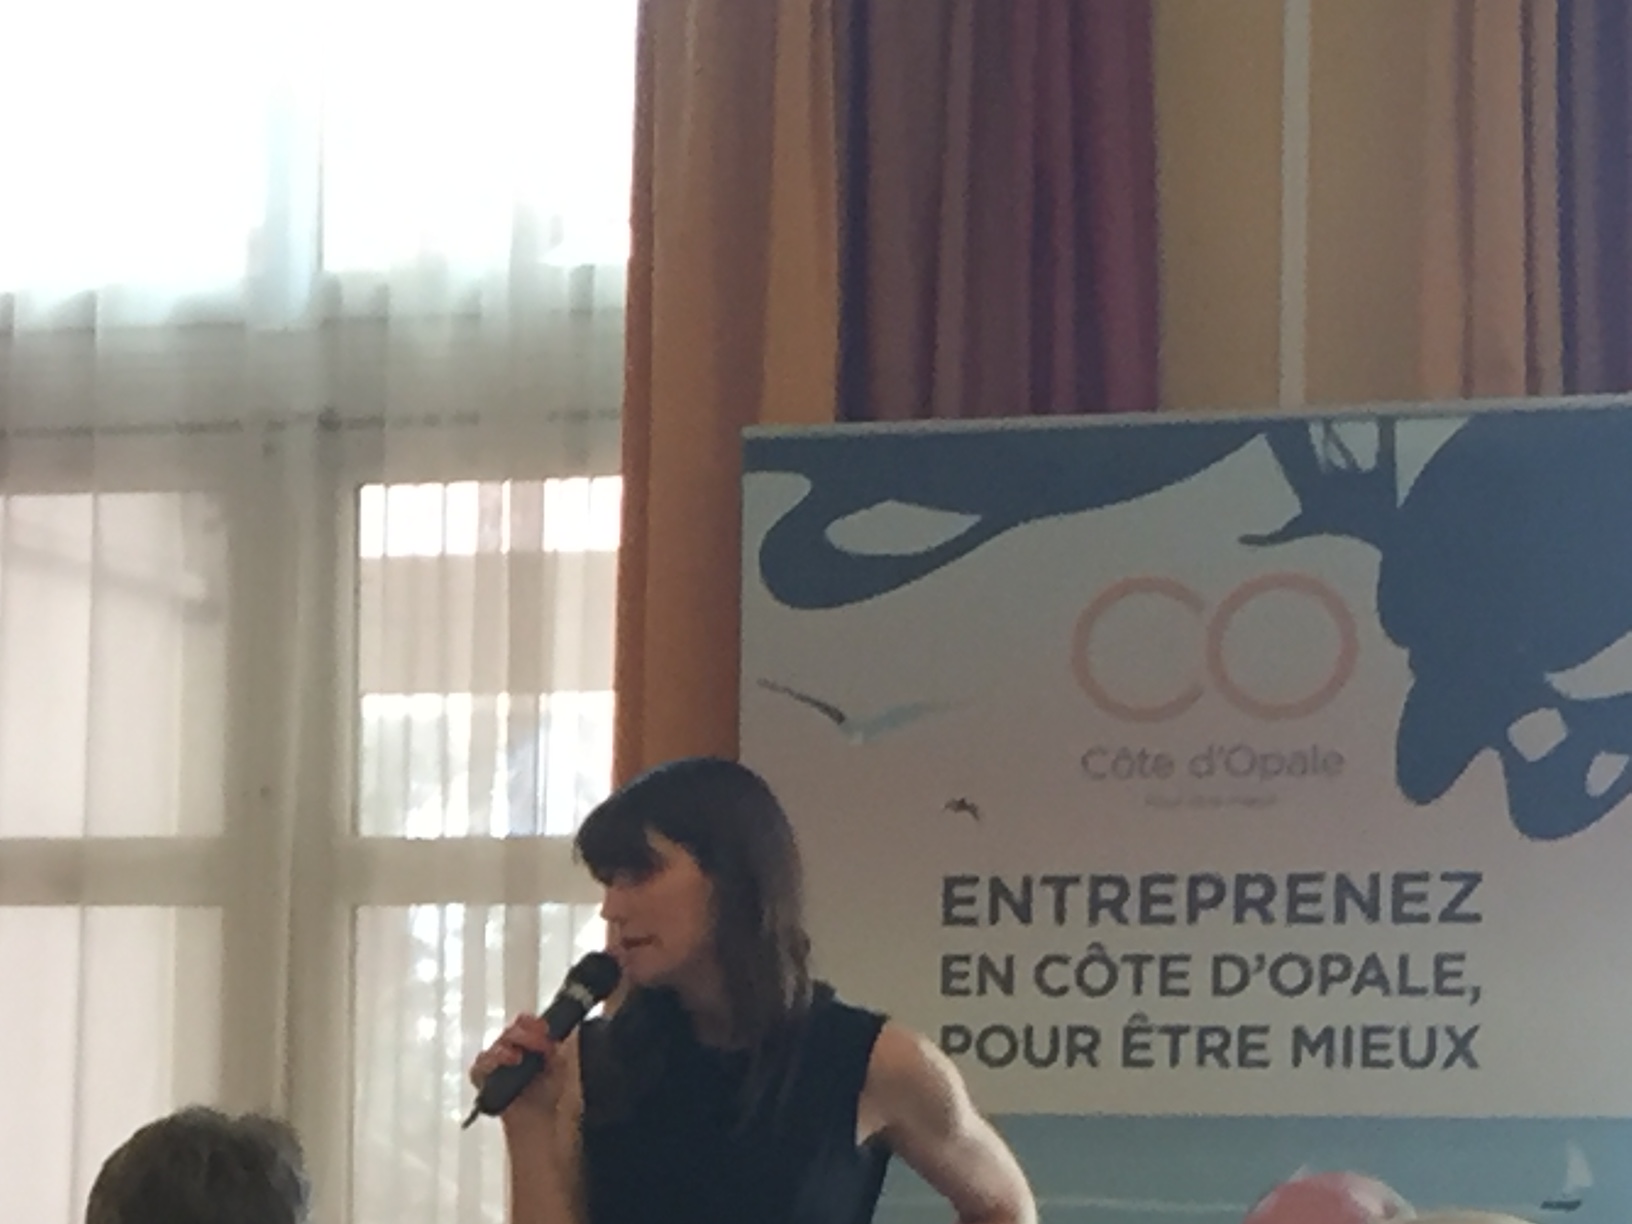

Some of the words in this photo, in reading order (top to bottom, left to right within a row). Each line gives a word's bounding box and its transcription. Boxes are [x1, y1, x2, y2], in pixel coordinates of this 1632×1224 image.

[1069, 574, 1359, 725] CO
[1079, 744, 1176, 781] Côte
[1187, 743, 1346, 784] d'Opale
[941, 871, 1484, 928] ENTREPRENEZ
[940, 953, 1015, 997] EN
[1033, 942, 1192, 998] CÔTE
[1211, 951, 1482, 1005] D'OPALE,
[939, 1022, 1102, 1069] POUR
[1121, 1012, 1271, 1069] ÊTRE
[1291, 1024, 1481, 1070] MIEUX
